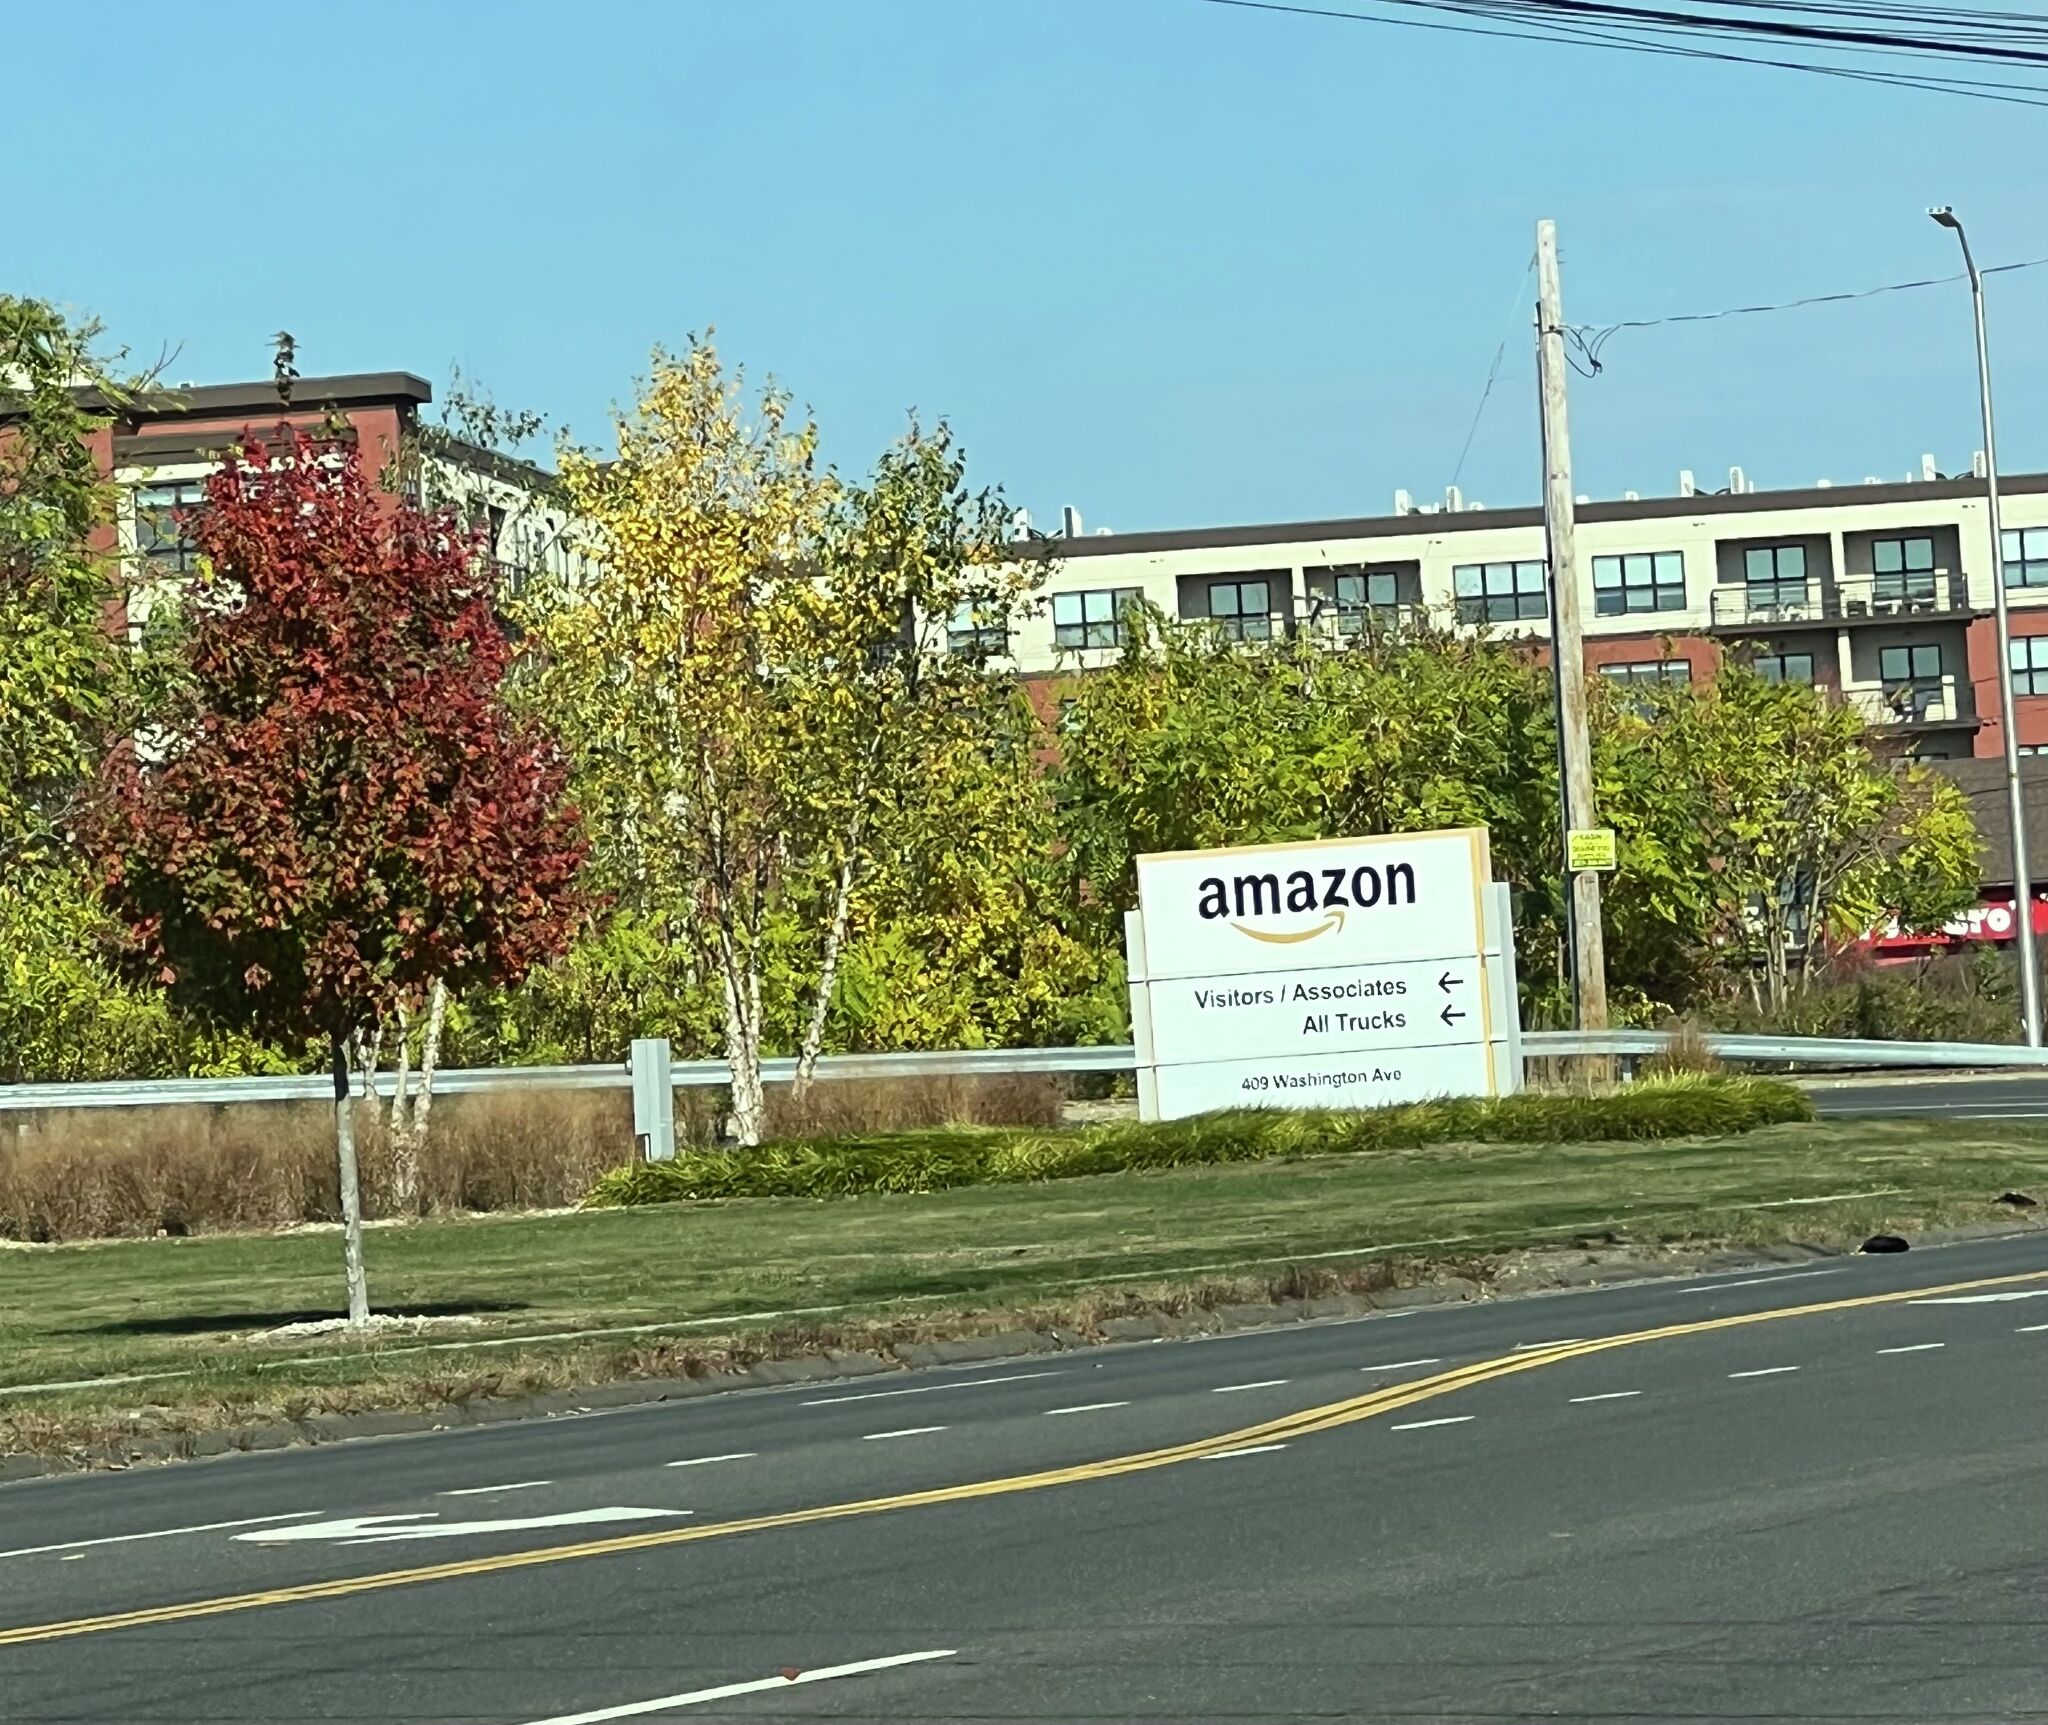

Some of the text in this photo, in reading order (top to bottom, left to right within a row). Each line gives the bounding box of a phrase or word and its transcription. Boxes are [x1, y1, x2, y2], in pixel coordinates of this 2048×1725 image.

[1198, 862, 1416, 920] amazon
[1194, 979, 1407, 1009] Visitors / Associates
[1302, 1010, 1407, 1035] All Trucks
[1241, 1076, 1269, 1091] 409
[1272, 1072, 1368, 1089] Washington
